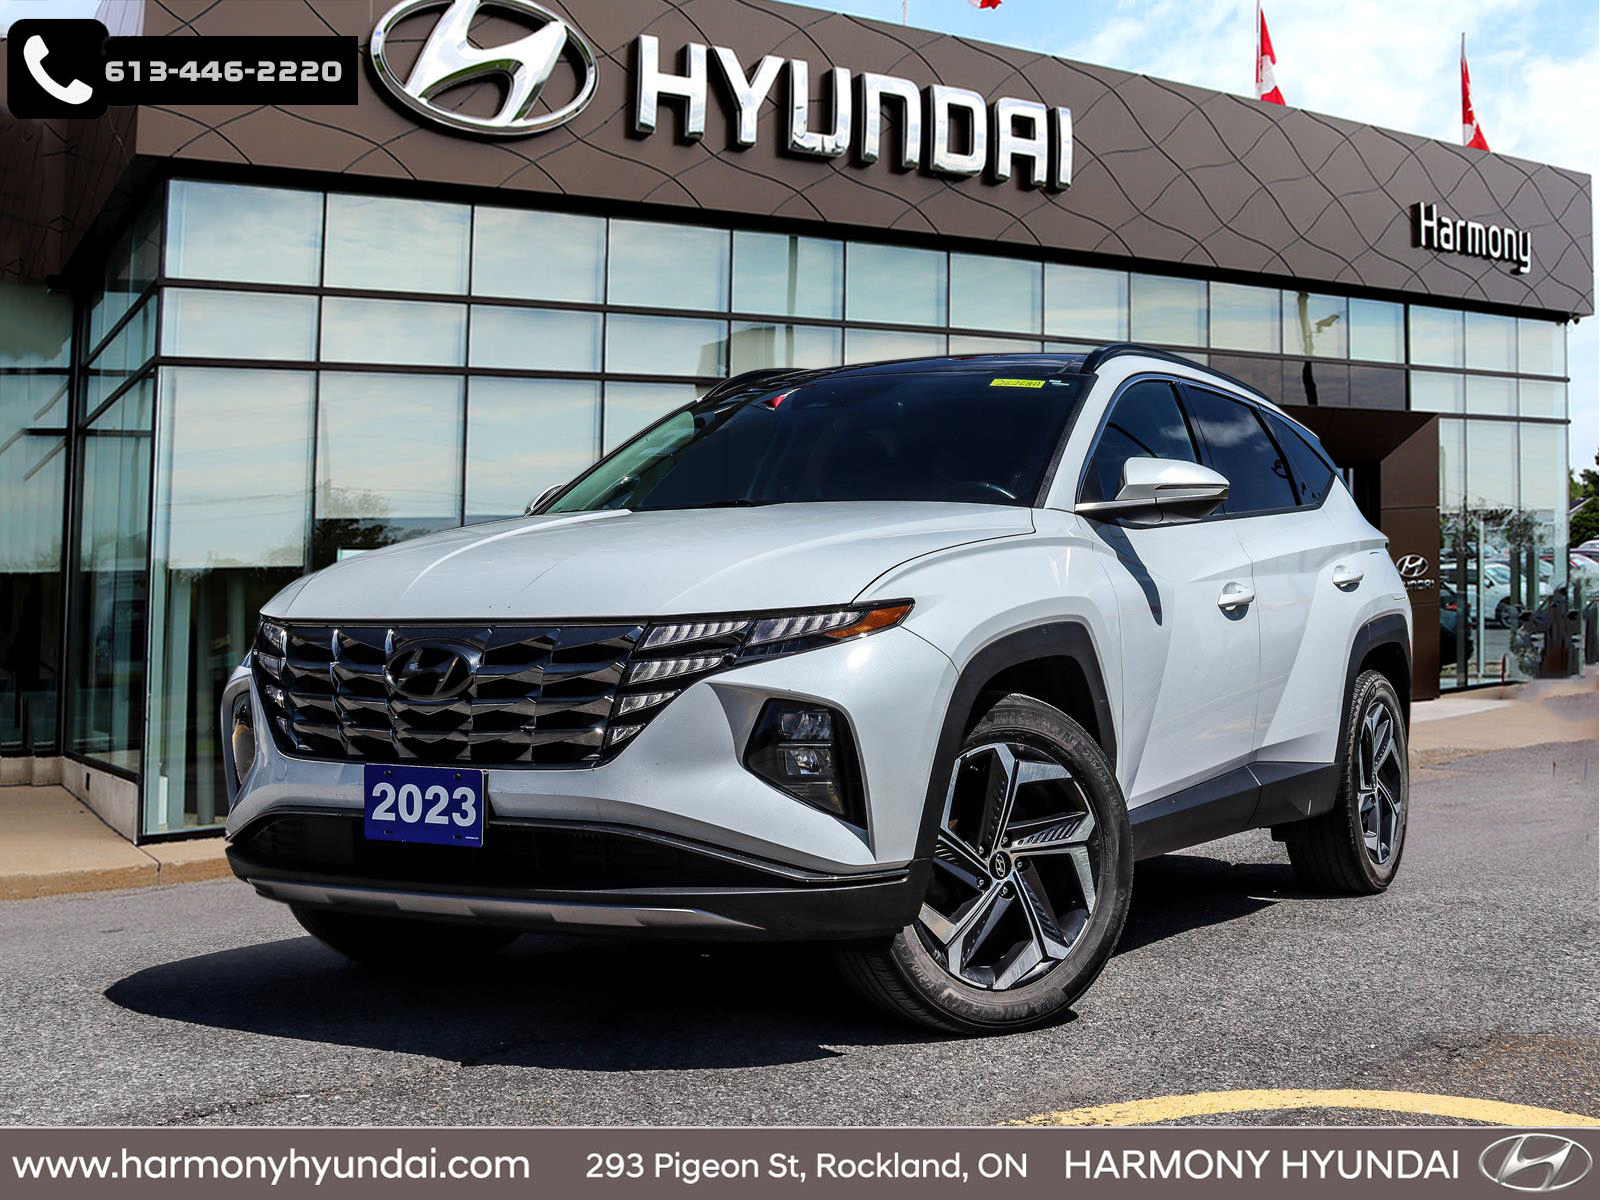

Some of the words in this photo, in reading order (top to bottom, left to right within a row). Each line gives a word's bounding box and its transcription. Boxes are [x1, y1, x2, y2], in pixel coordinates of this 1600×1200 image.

[636, 34, 1073, 190] HYUNDAI
[1418, 201, 1532, 274] Harmony
[371, 782, 477, 827] 2023
